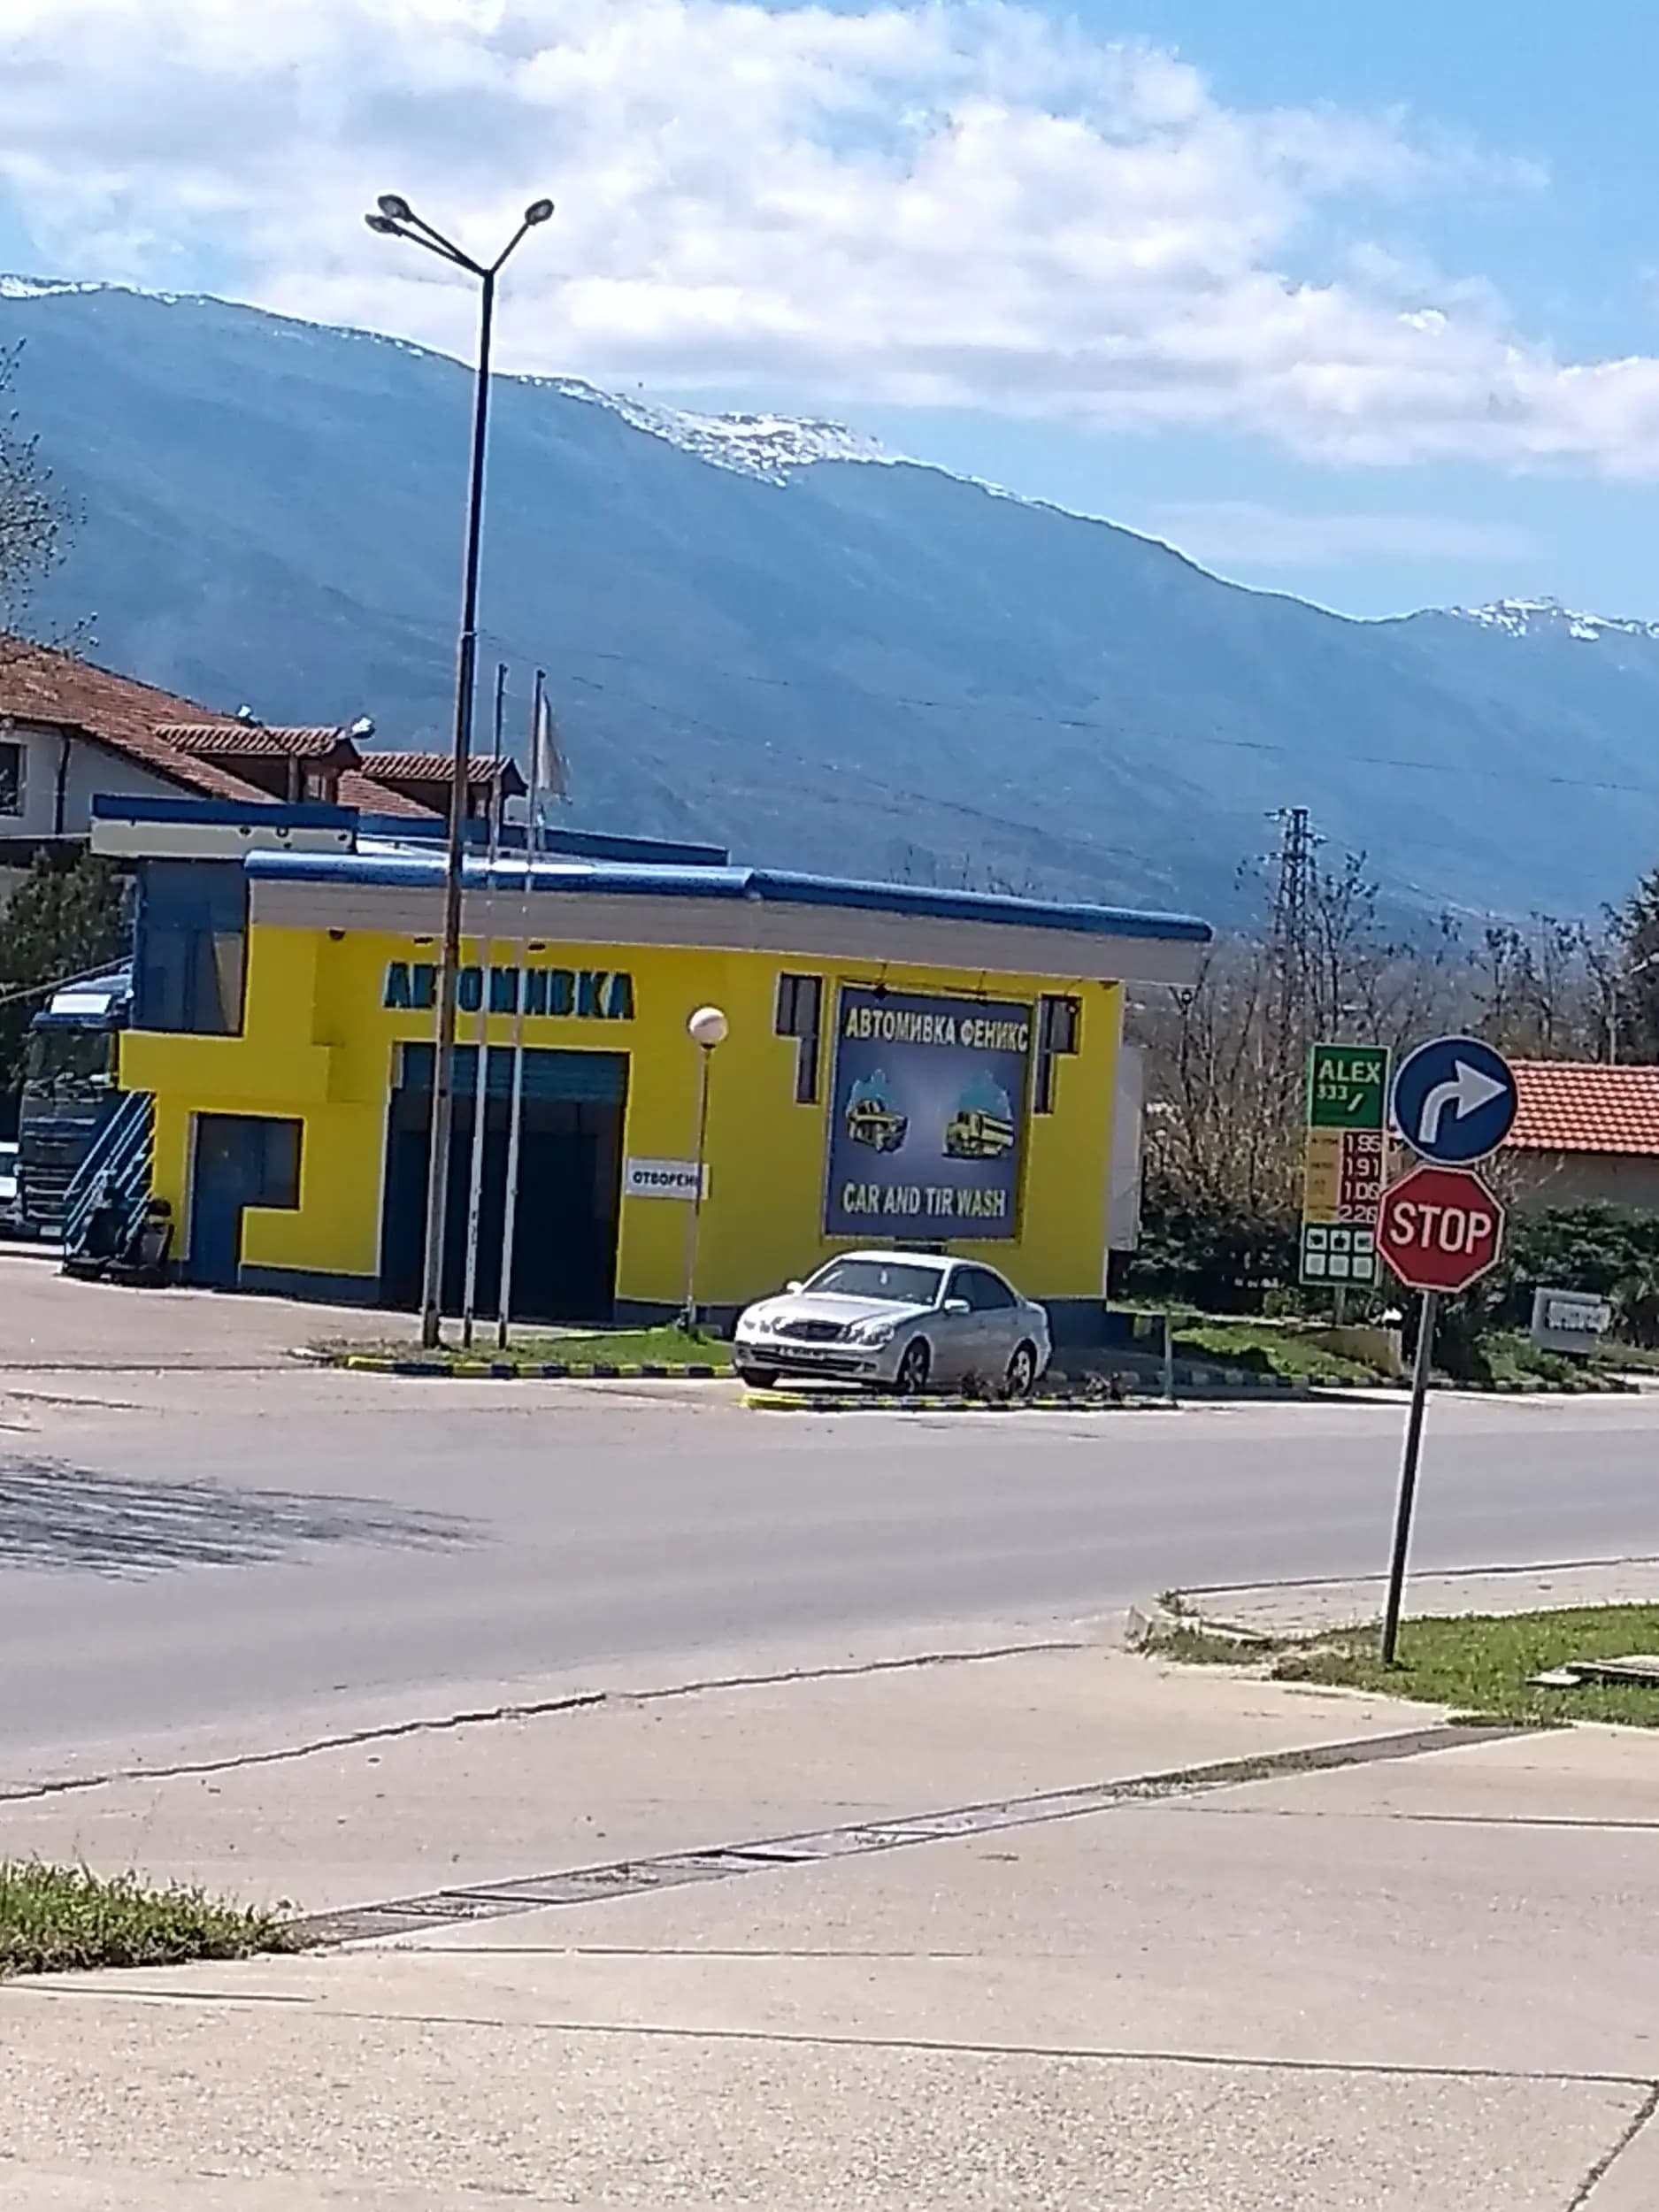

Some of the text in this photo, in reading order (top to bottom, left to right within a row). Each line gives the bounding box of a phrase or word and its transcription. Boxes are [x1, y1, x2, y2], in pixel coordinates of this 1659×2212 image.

[383, 960, 636, 1020] АВОМИВКА
[845, 1007, 1029, 1051] АВТОМИВКА ФЕНИКС
[1317, 1059, 1381, 1085] ALEX
[842, 1181, 1006, 1217] CAR AND TIR WASH
[1389, 1202, 1493, 1254] STOP
